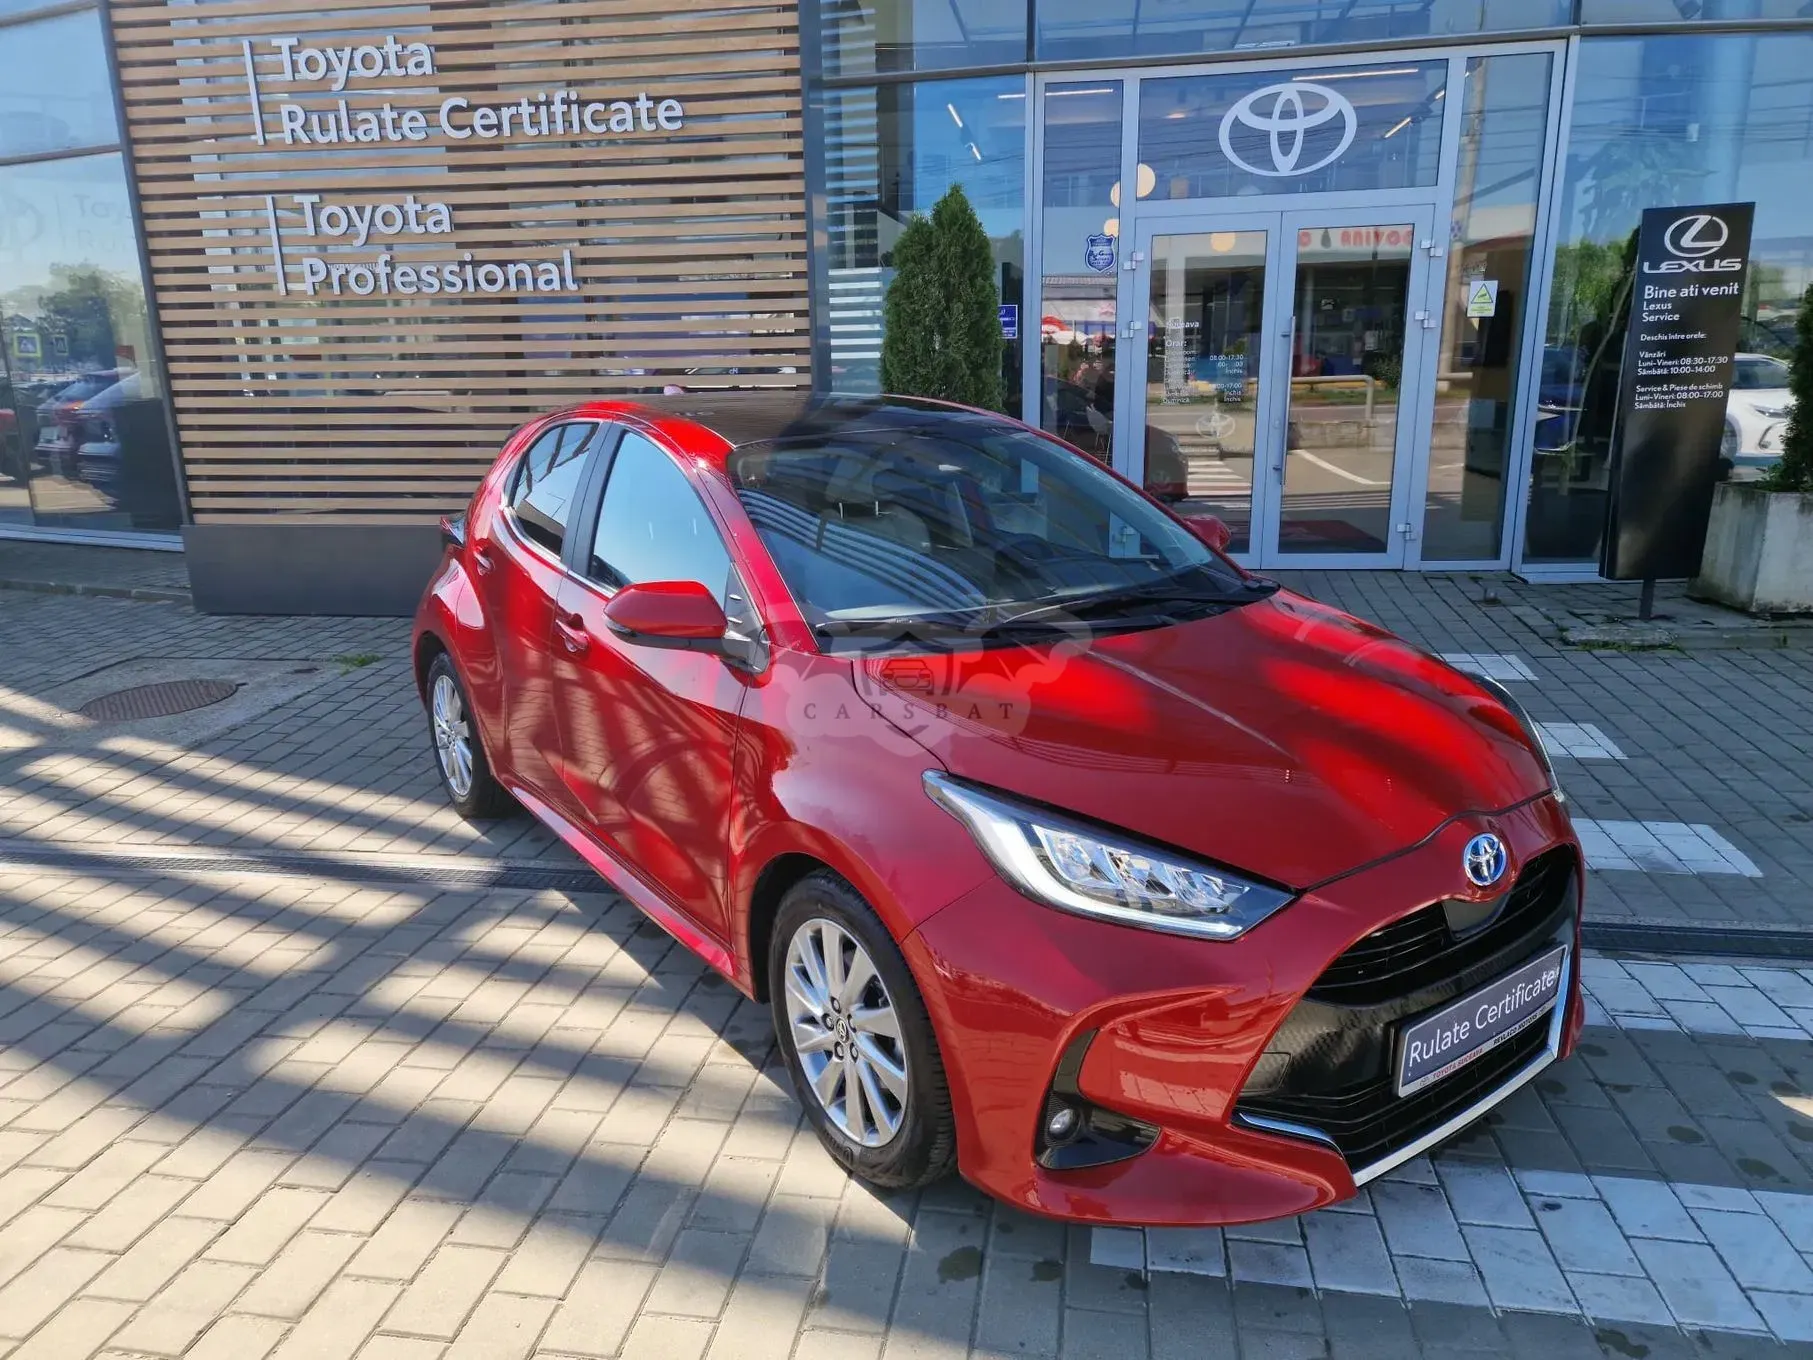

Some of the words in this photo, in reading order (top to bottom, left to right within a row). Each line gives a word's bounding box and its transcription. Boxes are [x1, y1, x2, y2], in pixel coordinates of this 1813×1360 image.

[272, 35, 436, 91] Toyota
[280, 99, 427, 145] Rulate
[439, 90, 685, 140] Certificate
[294, 195, 454, 247] Toyota
[302, 249, 580, 296] Professional
[1643, 258, 1742, 273] LEXUS
[1644, 284, 1677, 299] Bine
[1680, 285, 1699, 297] ati
[1701, 282, 1740, 296] venit
[1643, 301, 1672, 311] Lexus
[1642, 312, 1680, 322] Service
[1640, 333, 1667, 341] Deschis
[1636, 385, 1662, 393] Service
[1409, 1020, 1470, 1068] Rulate
[1475, 969, 1556, 1030] Certificate
